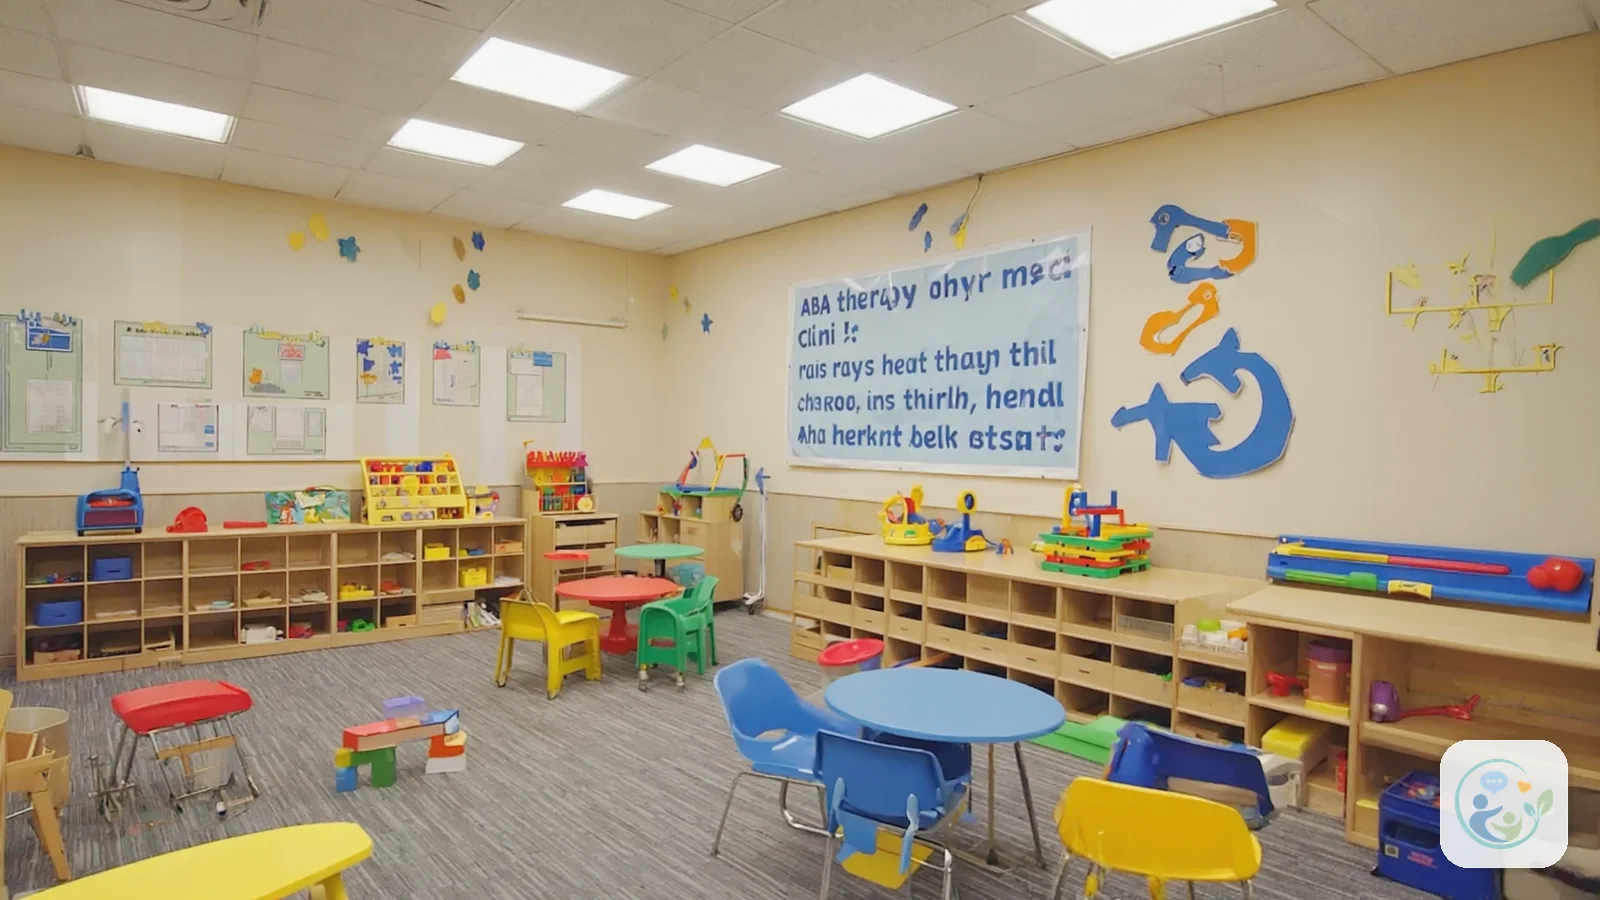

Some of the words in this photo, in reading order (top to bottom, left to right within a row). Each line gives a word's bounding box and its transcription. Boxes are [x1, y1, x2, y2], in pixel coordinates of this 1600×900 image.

[800, 294, 831, 317] ABA
[833, 359, 875, 382] rays
[882, 351, 927, 376] heat
[1009, 339, 1056, 367] thil
[867, 390, 895, 411] ins
[986, 382, 1065, 410] hendl
